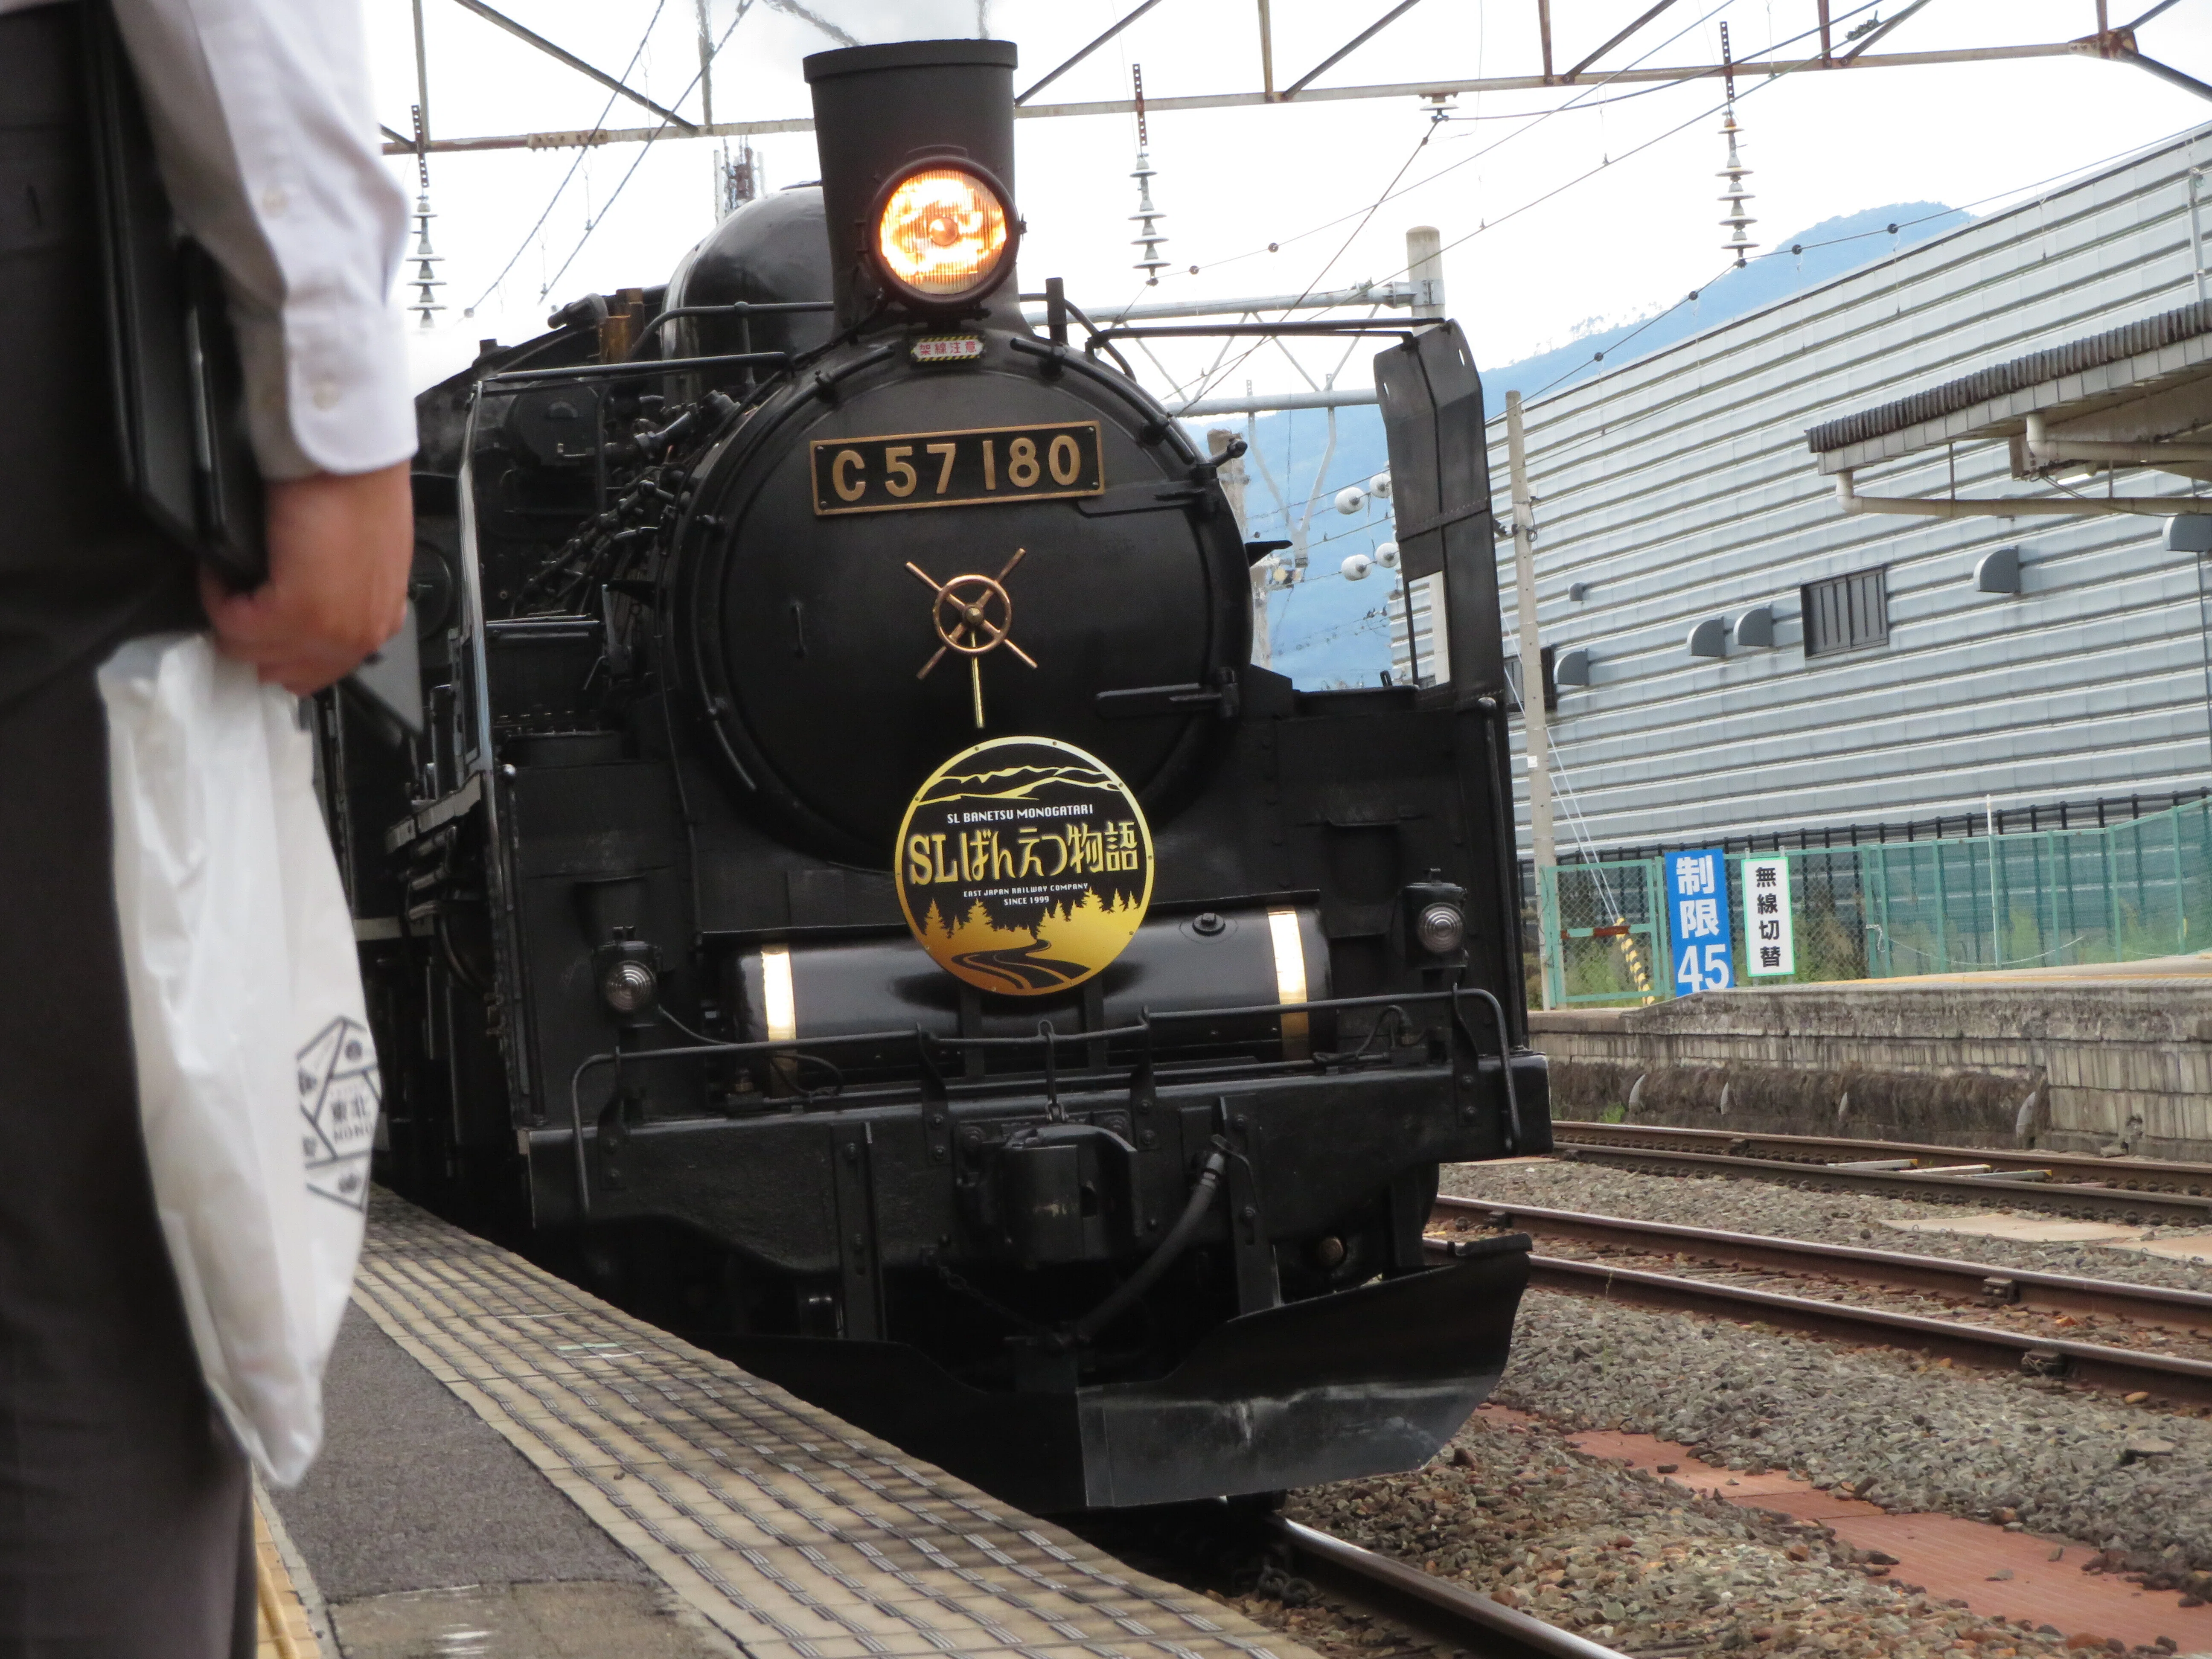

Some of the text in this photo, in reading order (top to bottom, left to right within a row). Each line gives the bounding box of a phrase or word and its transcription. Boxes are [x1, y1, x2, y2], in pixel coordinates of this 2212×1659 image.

[920, 341, 976, 355] 架線注意
[982, 434, 1081, 490] 180
[947, 804, 1093, 824] SL BANETSU MONOGATARI
[910, 822, 1138, 885] SLばんえつ物語
[984, 888, 1010, 896] JAPAN
[1012, 885, 1048, 894] RAILWAY
[1050, 882, 1089, 891] COMPANY
[1004, 896, 1050, 906] SINCE 1999
[1676, 855, 1720, 939] 制限
[1755, 867, 1781, 968] 無線切替
[1677, 943, 1729, 992] 45
